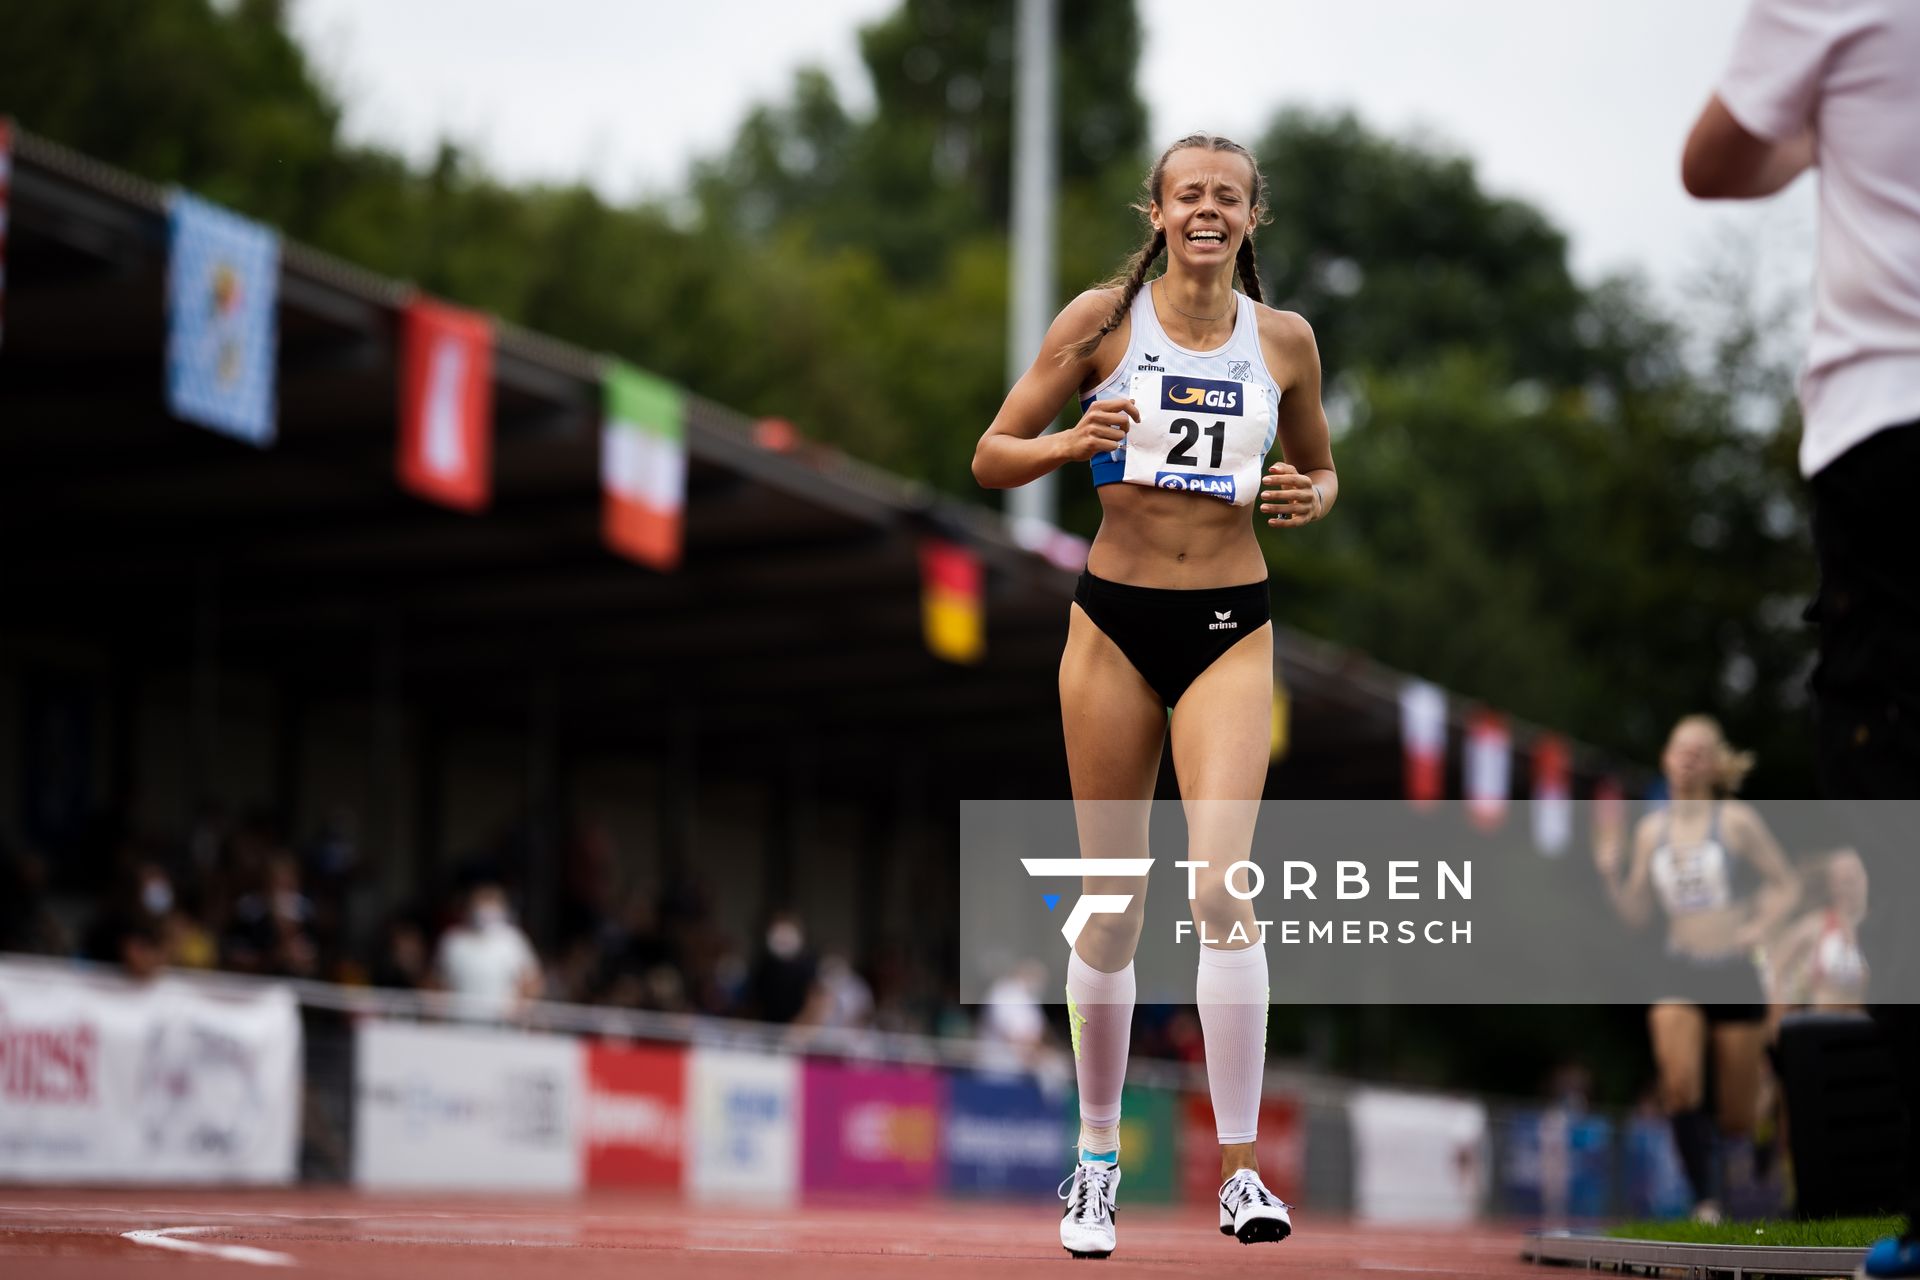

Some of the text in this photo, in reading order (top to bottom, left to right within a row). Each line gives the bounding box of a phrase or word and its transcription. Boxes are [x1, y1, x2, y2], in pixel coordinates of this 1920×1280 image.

[1138, 364, 1165, 372] erima
[1205, 390, 1237, 408] GLS
[1166, 418, 1225, 468] 21
[1190, 479, 1233, 493] PLAN
[1208, 621, 1238, 630] erima
